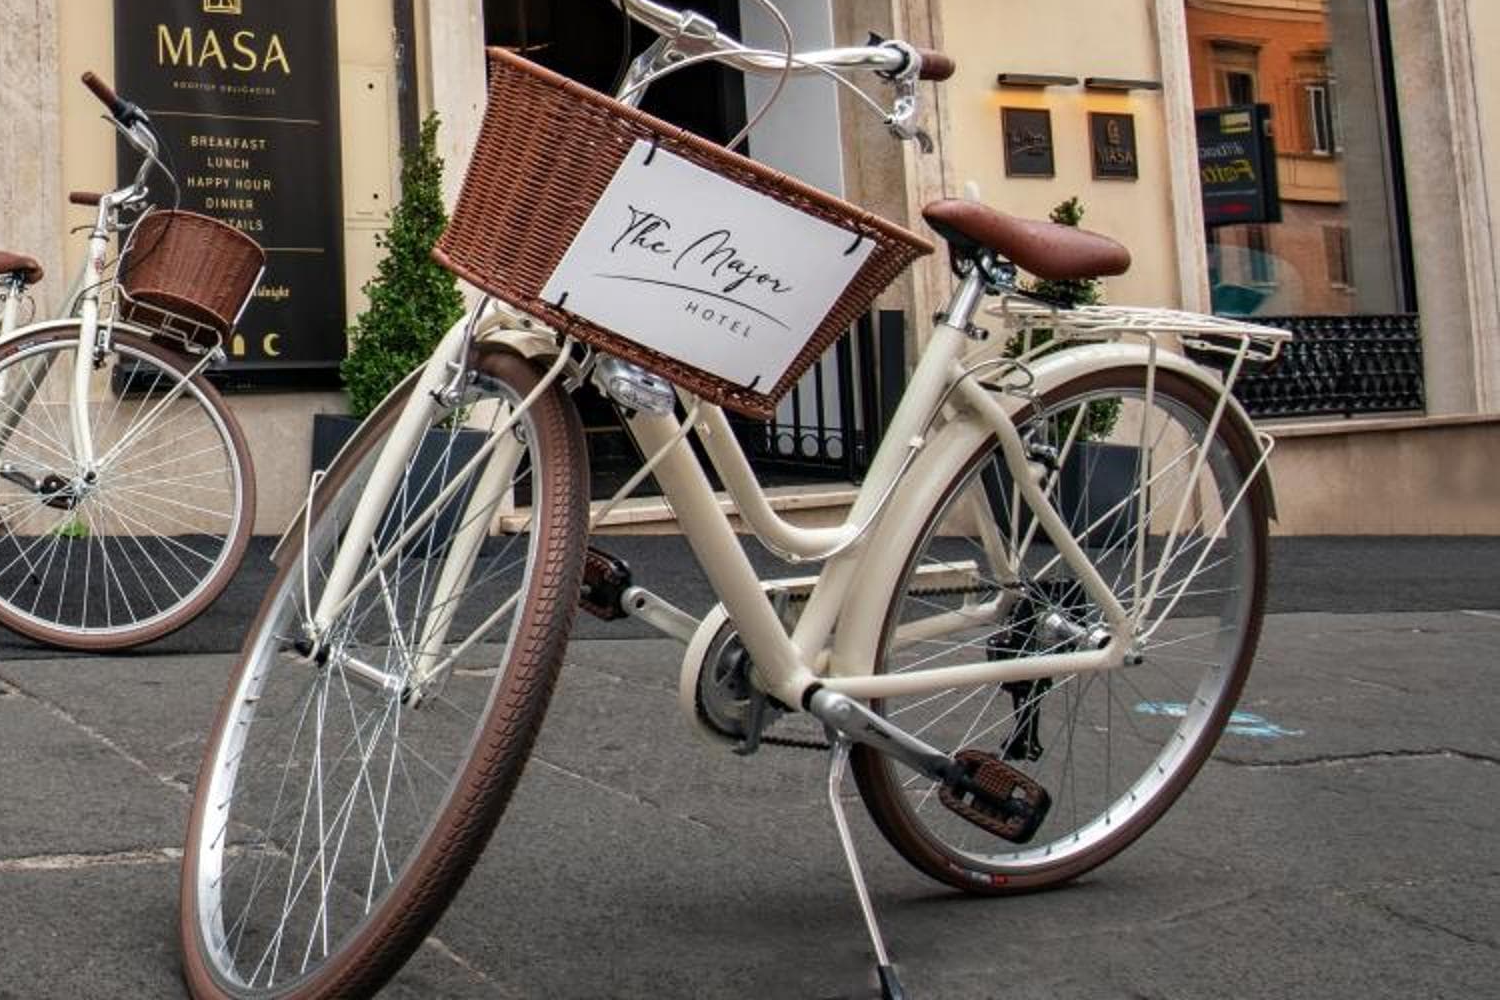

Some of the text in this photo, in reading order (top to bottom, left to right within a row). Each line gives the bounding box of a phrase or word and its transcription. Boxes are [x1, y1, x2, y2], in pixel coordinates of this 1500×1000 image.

[157, 23, 291, 75] MASA
[190, 135, 266, 150] BREAKFAST
[206, 156, 250, 169] LUNCH
[187, 176, 272, 191] HAPPY HOUR
[205, 197, 254, 209] DINNER
[223, 217, 263, 231] TAILS
[611, 204, 794, 294] The Major
[252, 284, 290, 302] idnight
[684, 301, 751, 338] HOTEL
